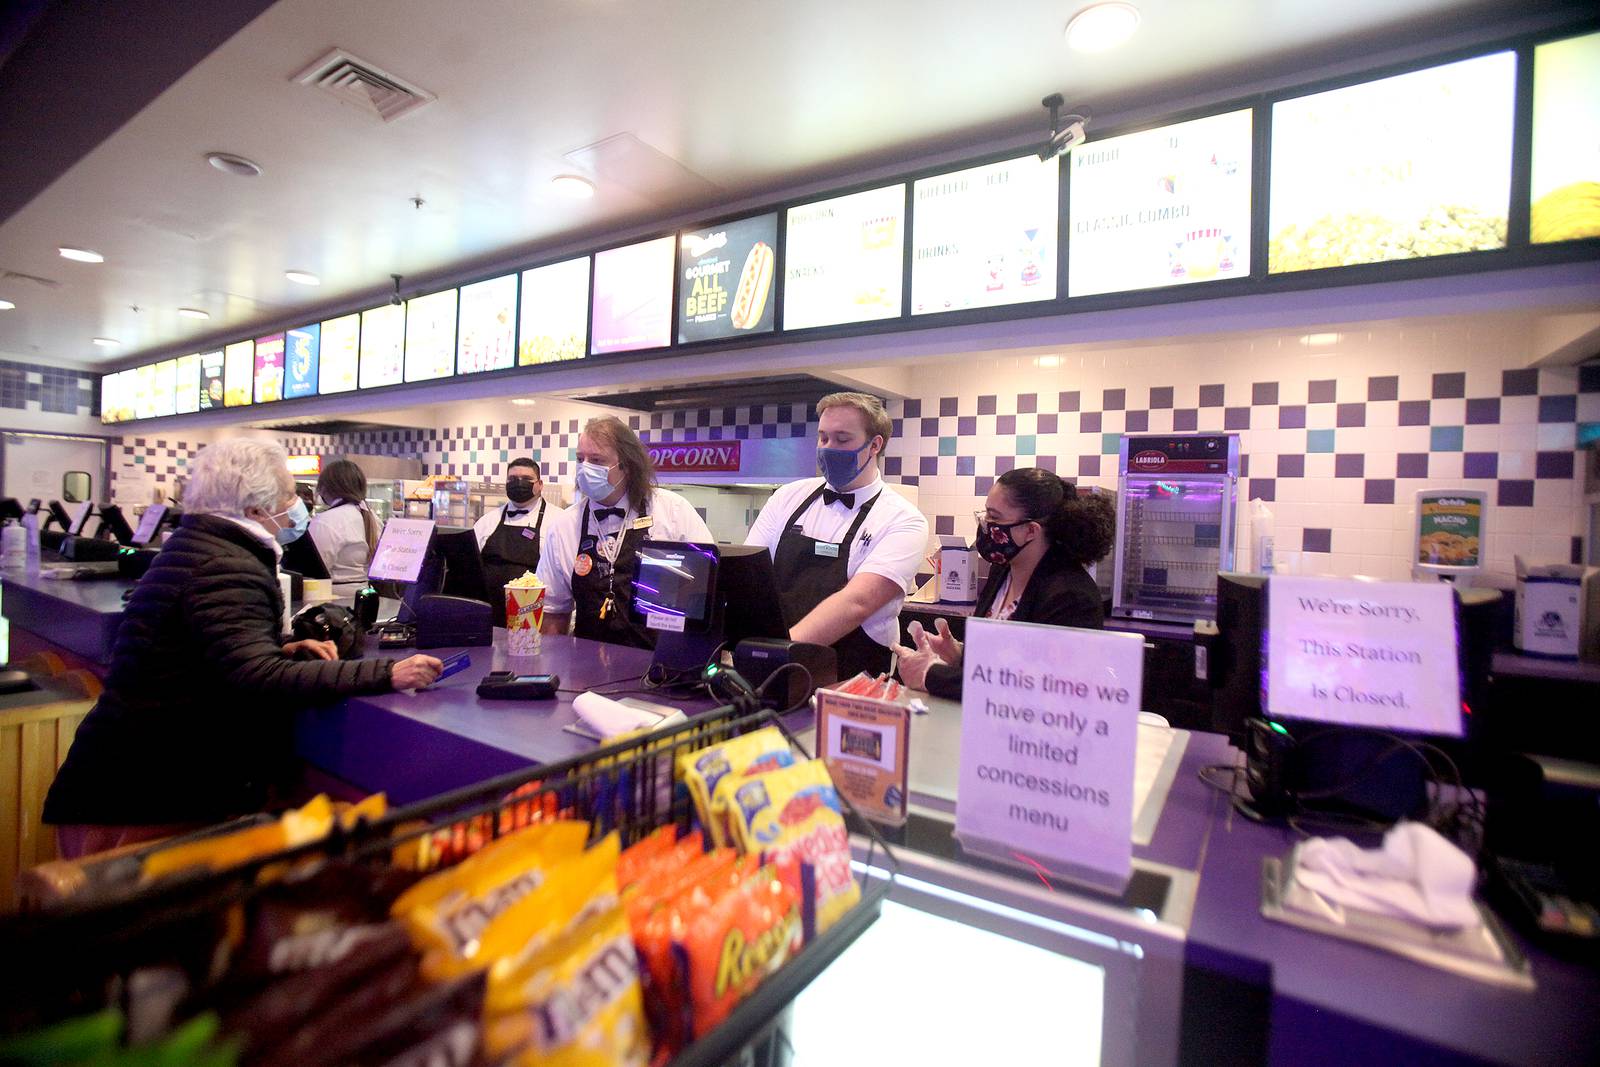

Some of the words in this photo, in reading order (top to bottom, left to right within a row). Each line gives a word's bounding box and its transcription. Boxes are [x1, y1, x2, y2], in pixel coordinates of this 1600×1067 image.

[1138, 204, 1190, 224] COMBO
[918, 243, 960, 260] DRINKS
[685, 260, 731, 279] GOURMET
[691, 273, 723, 297] ALL
[686, 292, 728, 317] BEEF
[648, 446, 732, 467] OPCORN
[1432, 515, 1468, 525] NACHO
[1297, 597, 1353, 615] We're
[1298, 639, 1342, 657] This
[1346, 643, 1422, 664] Station
[971, 663, 993, 685] At
[999, 667, 1035, 690] this
[1042, 673, 1089, 698] time
[1096, 685, 1130, 704] we
[1312, 683, 1329, 699] Is
[985, 697, 1036, 723] have
[1042, 711, 1088, 737] only
[1095, 719, 1110, 737] a
[1008, 733, 1079, 766] limited
[977, 764, 1111, 808] concessions
[1008, 803, 1069, 832] menu
